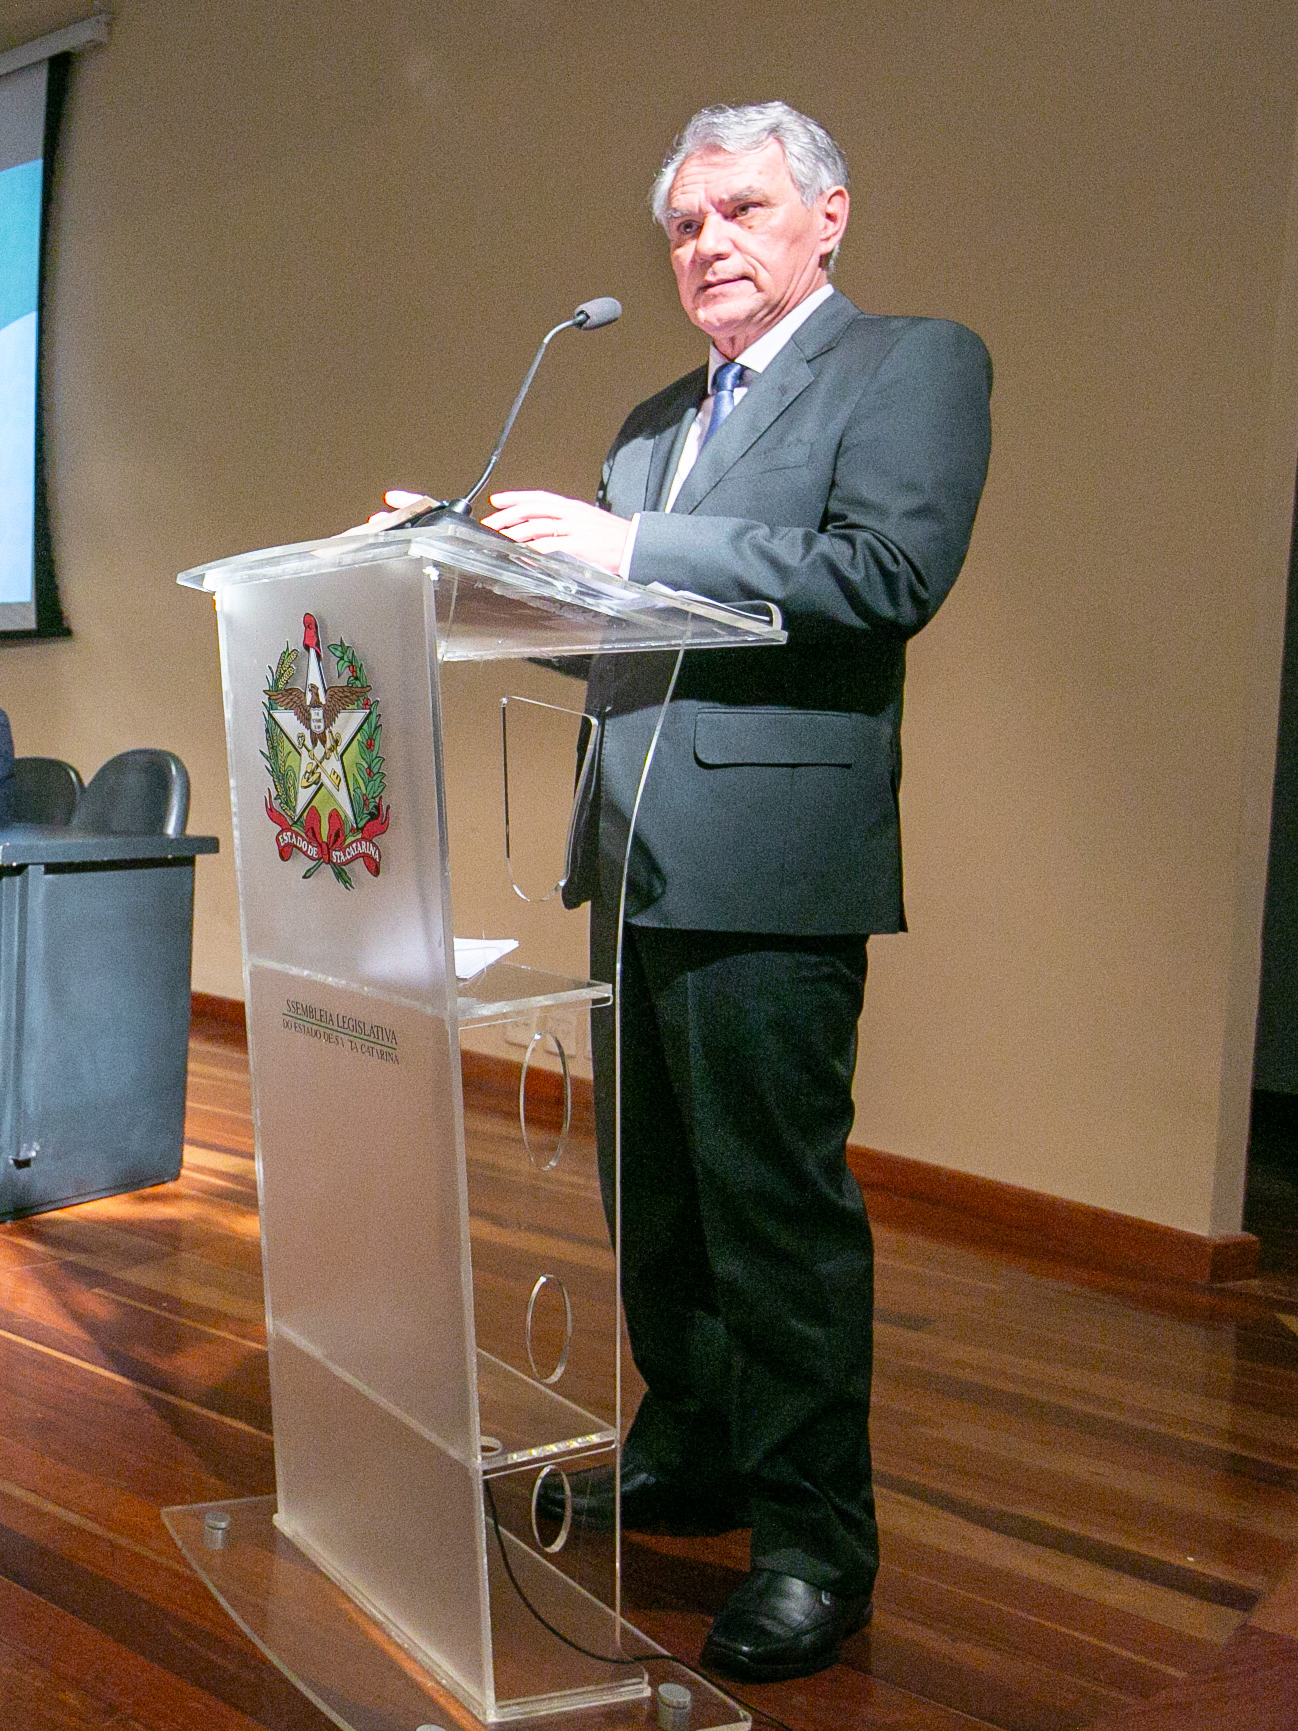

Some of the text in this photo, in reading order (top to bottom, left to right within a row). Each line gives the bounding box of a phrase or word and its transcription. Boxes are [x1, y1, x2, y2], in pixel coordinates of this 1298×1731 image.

[278, 831, 307, 851] ESTADO
[307, 845, 319, 858] DE
[336, 1013, 398, 1046] LEGISLATIVA
